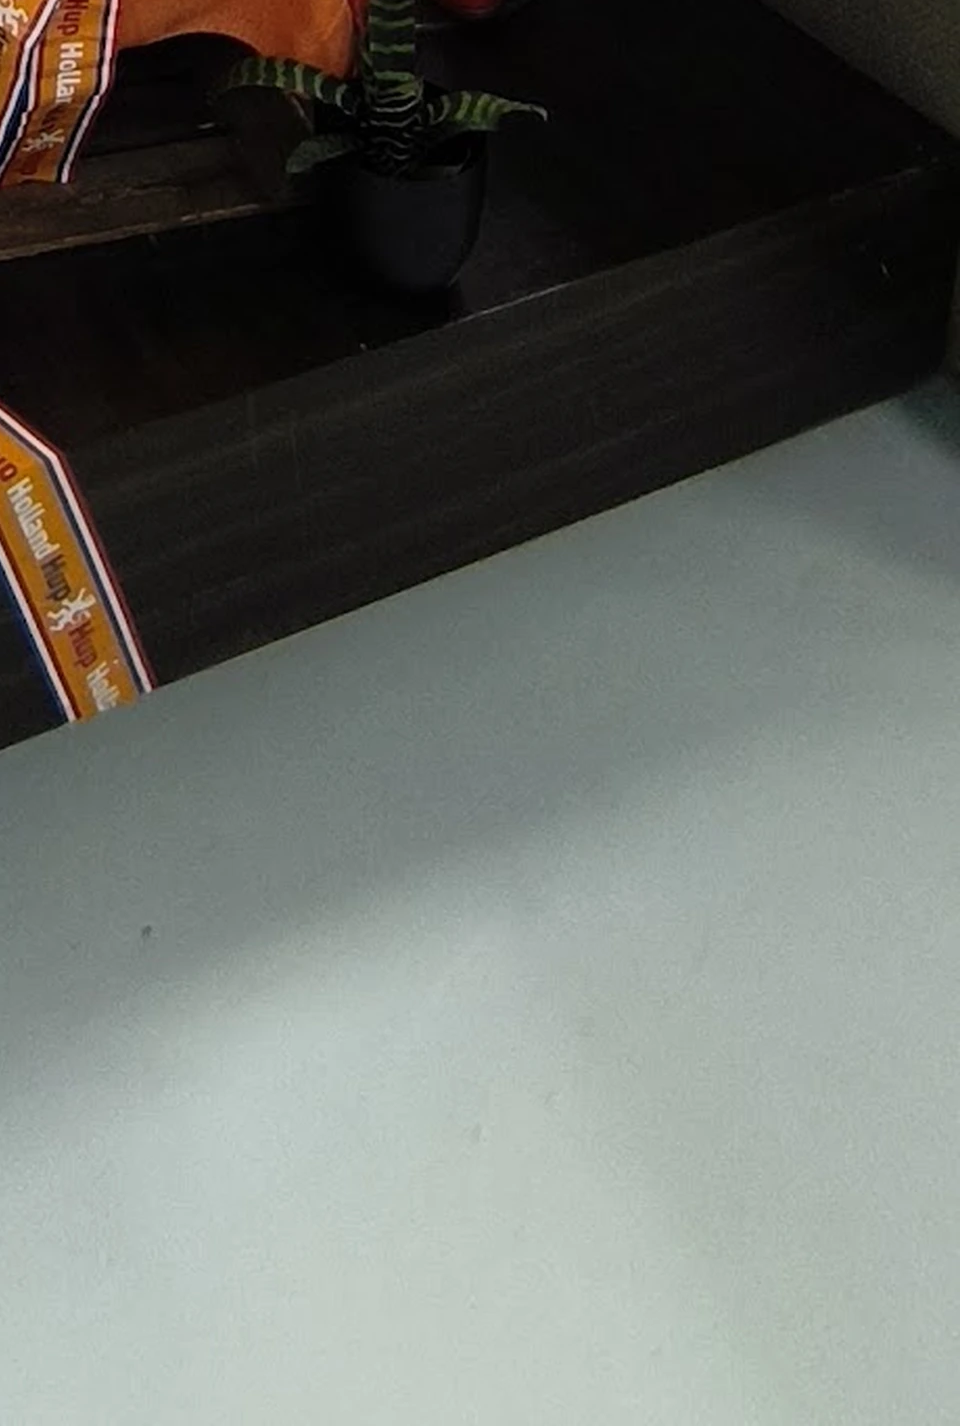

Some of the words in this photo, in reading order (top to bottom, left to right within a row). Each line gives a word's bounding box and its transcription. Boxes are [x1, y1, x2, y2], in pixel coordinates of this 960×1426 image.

[7, 477, 61, 561] Holland
[41, 553, 73, 602] Hup
[68, 618, 98, 668] Hup
